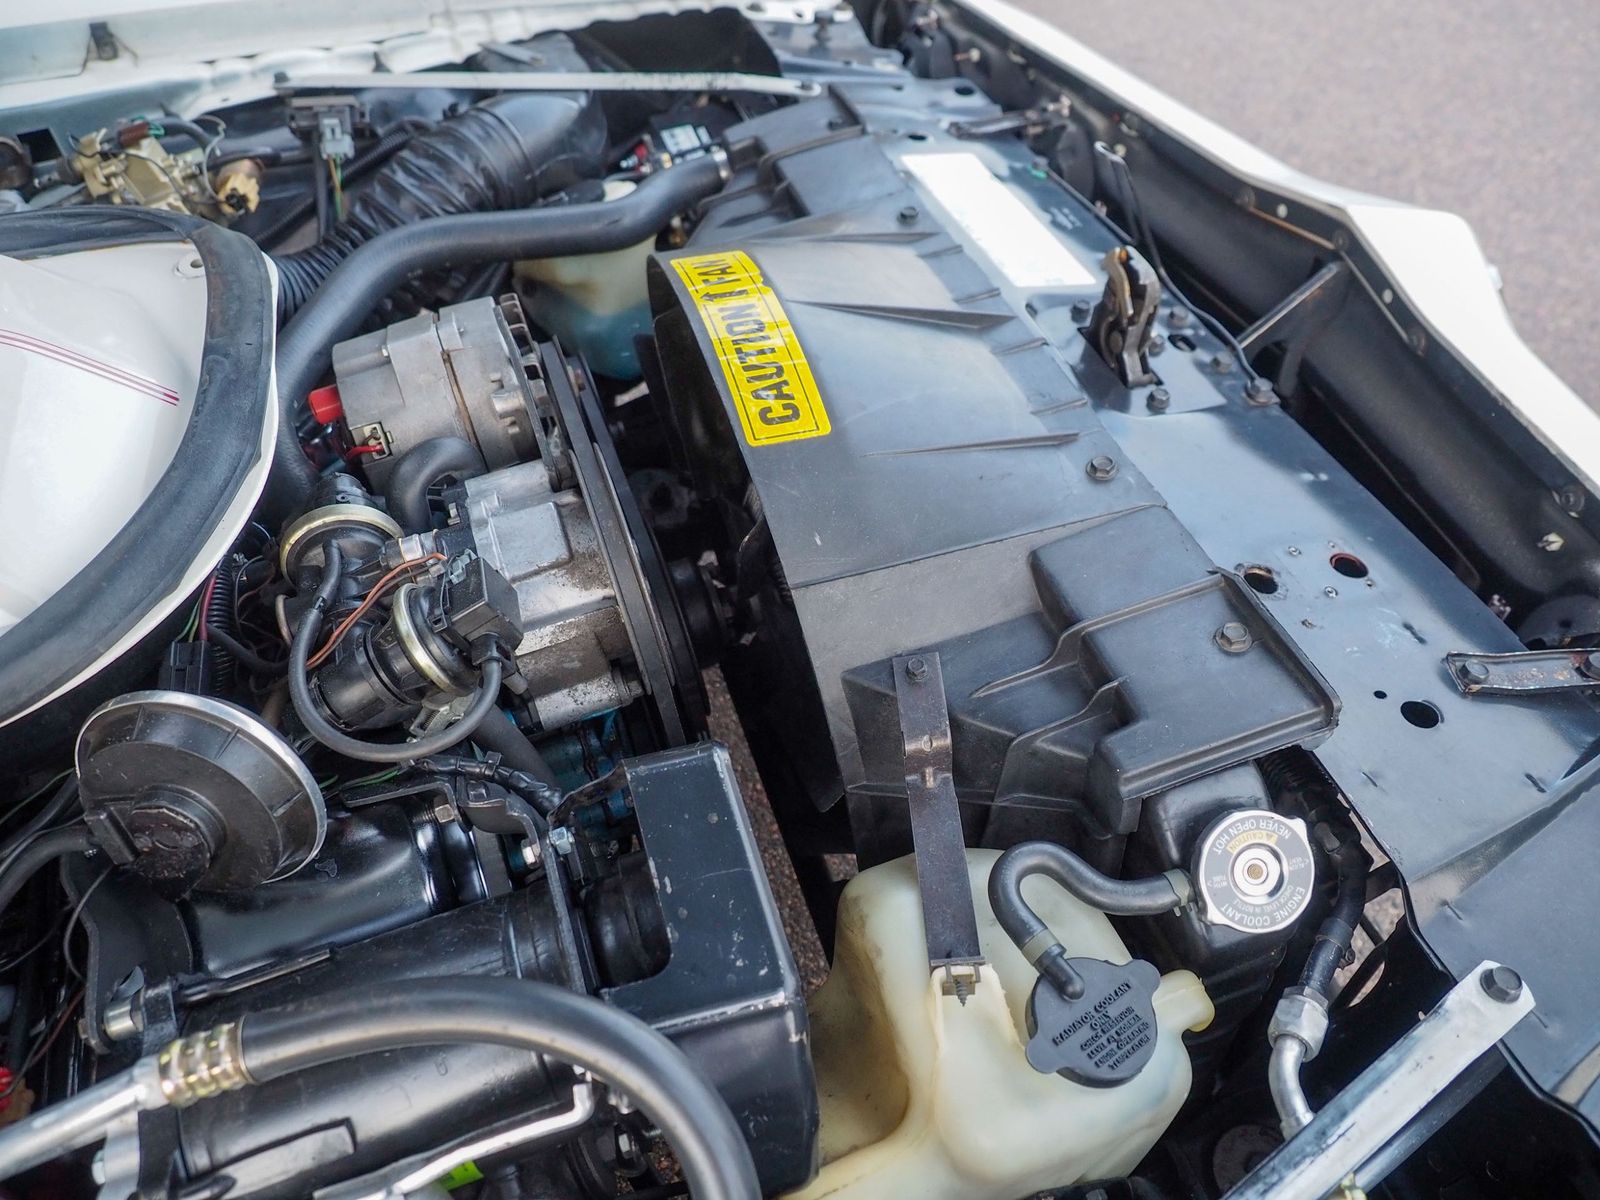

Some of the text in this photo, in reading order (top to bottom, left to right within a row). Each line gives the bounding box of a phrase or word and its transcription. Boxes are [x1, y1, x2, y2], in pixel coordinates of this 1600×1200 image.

[691, 258, 801, 426] CAUTION FAN
[1213, 818, 1292, 856] NEVER OPEN HOT
[1229, 831, 1265, 851] CAUTION
[1220, 887, 1306, 927] ENGINE COOLANT
[1052, 981, 1132, 1046] RADIATOR COOLANT
[1090, 1010, 1112, 1031] ONLY
[1080, 1030, 1102, 1051] CHECK
[1087, 1041, 1108, 1060] LEVEL
